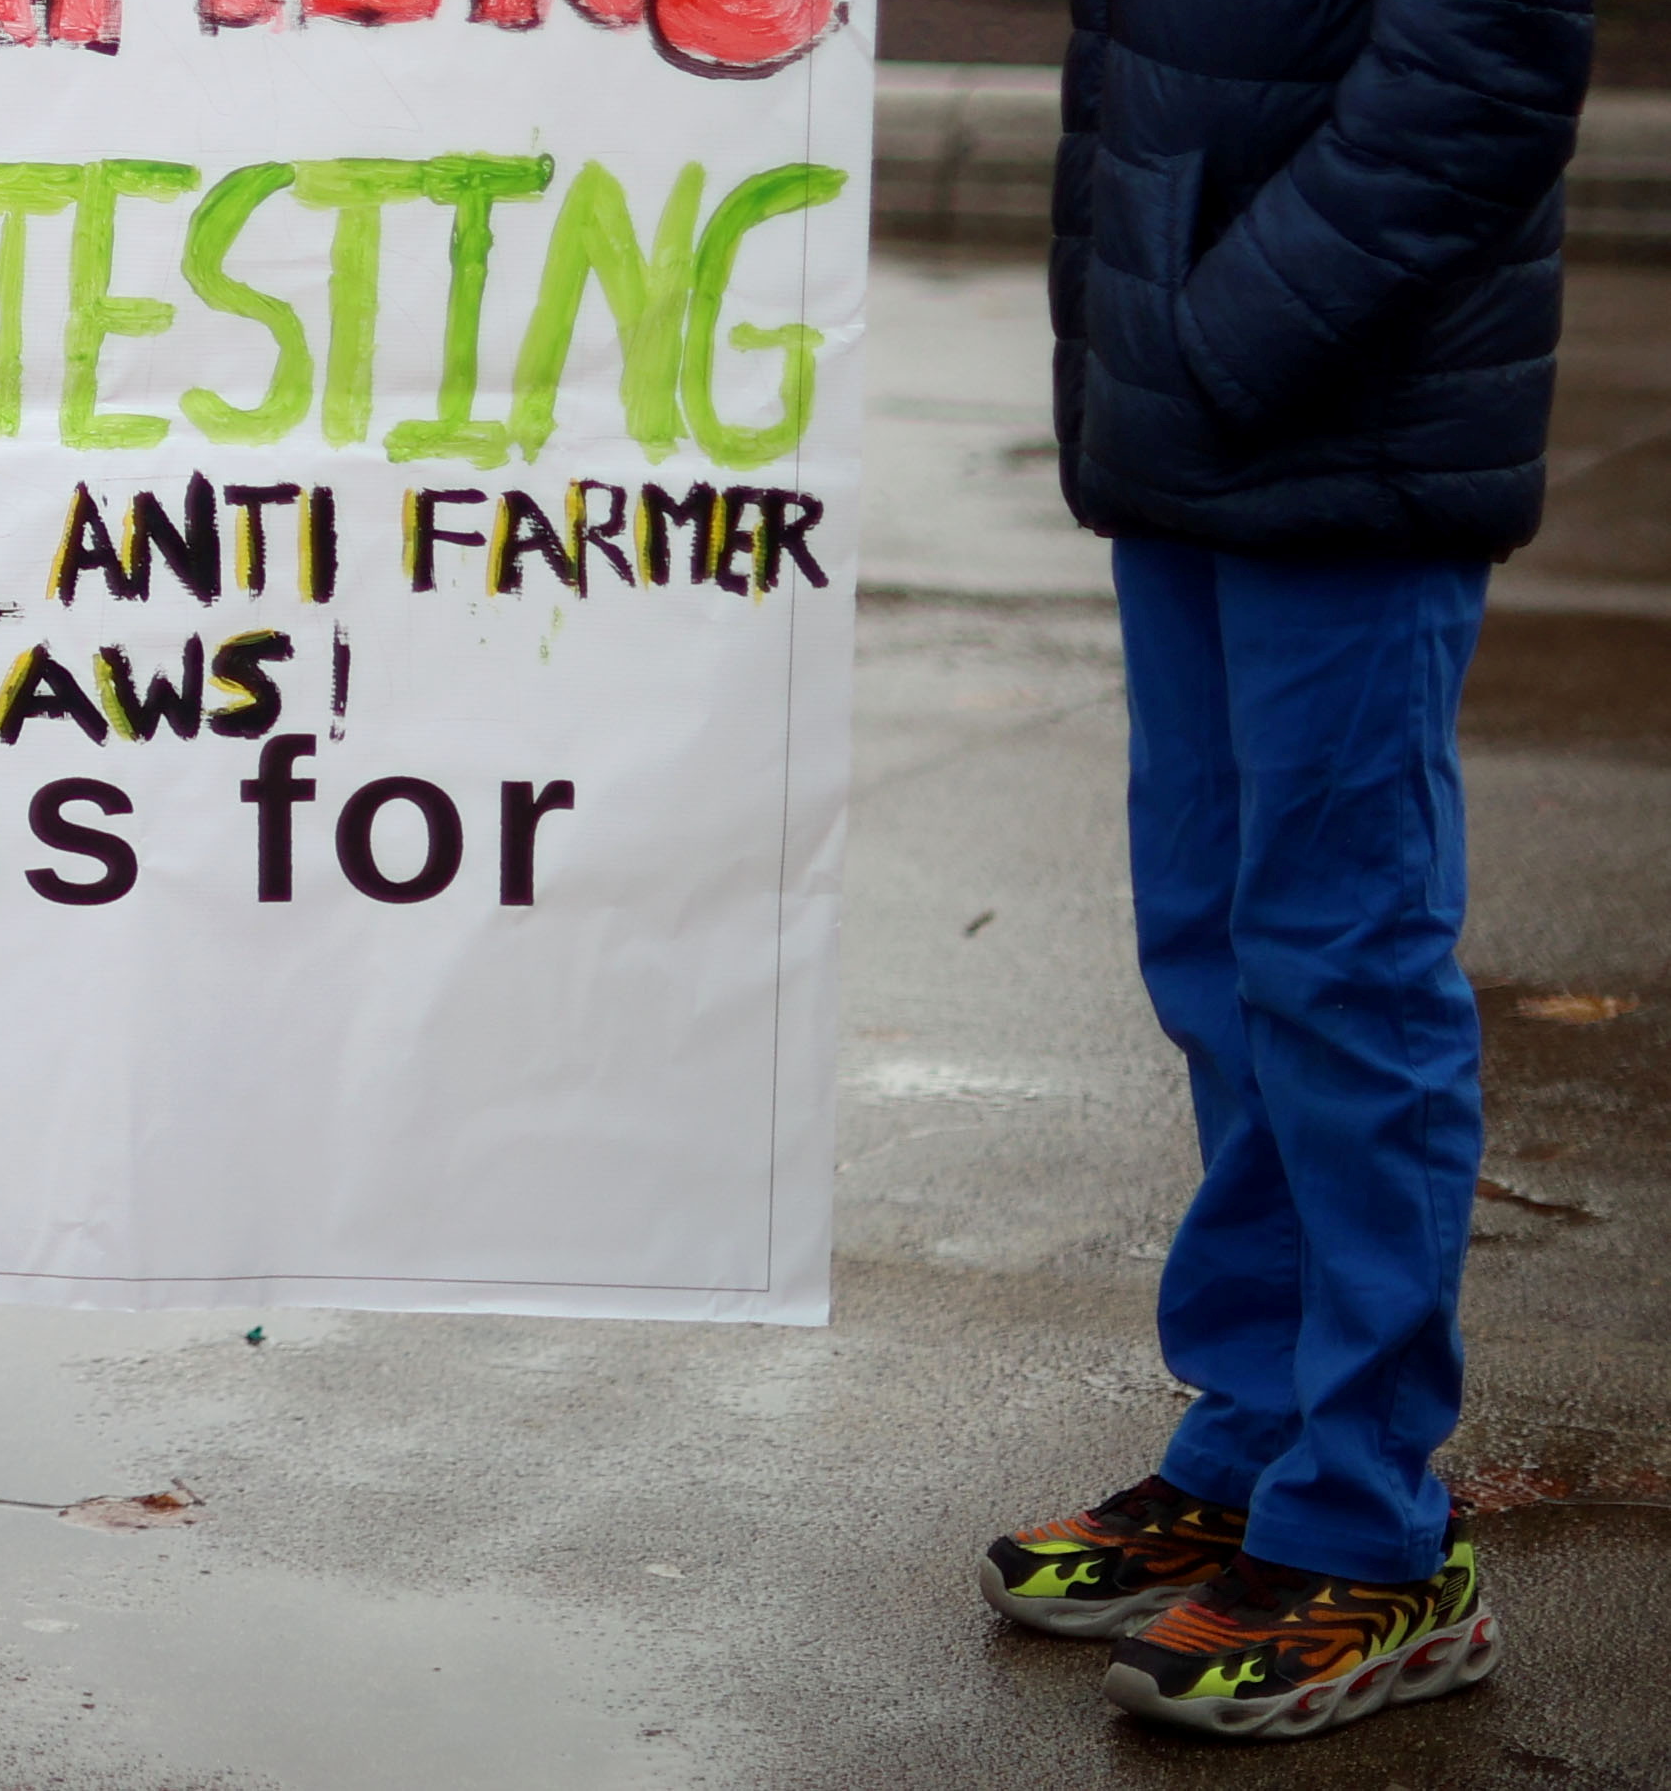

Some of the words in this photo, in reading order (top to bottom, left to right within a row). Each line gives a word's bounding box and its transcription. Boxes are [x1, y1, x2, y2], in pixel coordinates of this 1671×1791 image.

[48, 470, 338, 604] ANTI
[402, 478, 828, 604] FARMER
[240, 734, 575, 907] for
